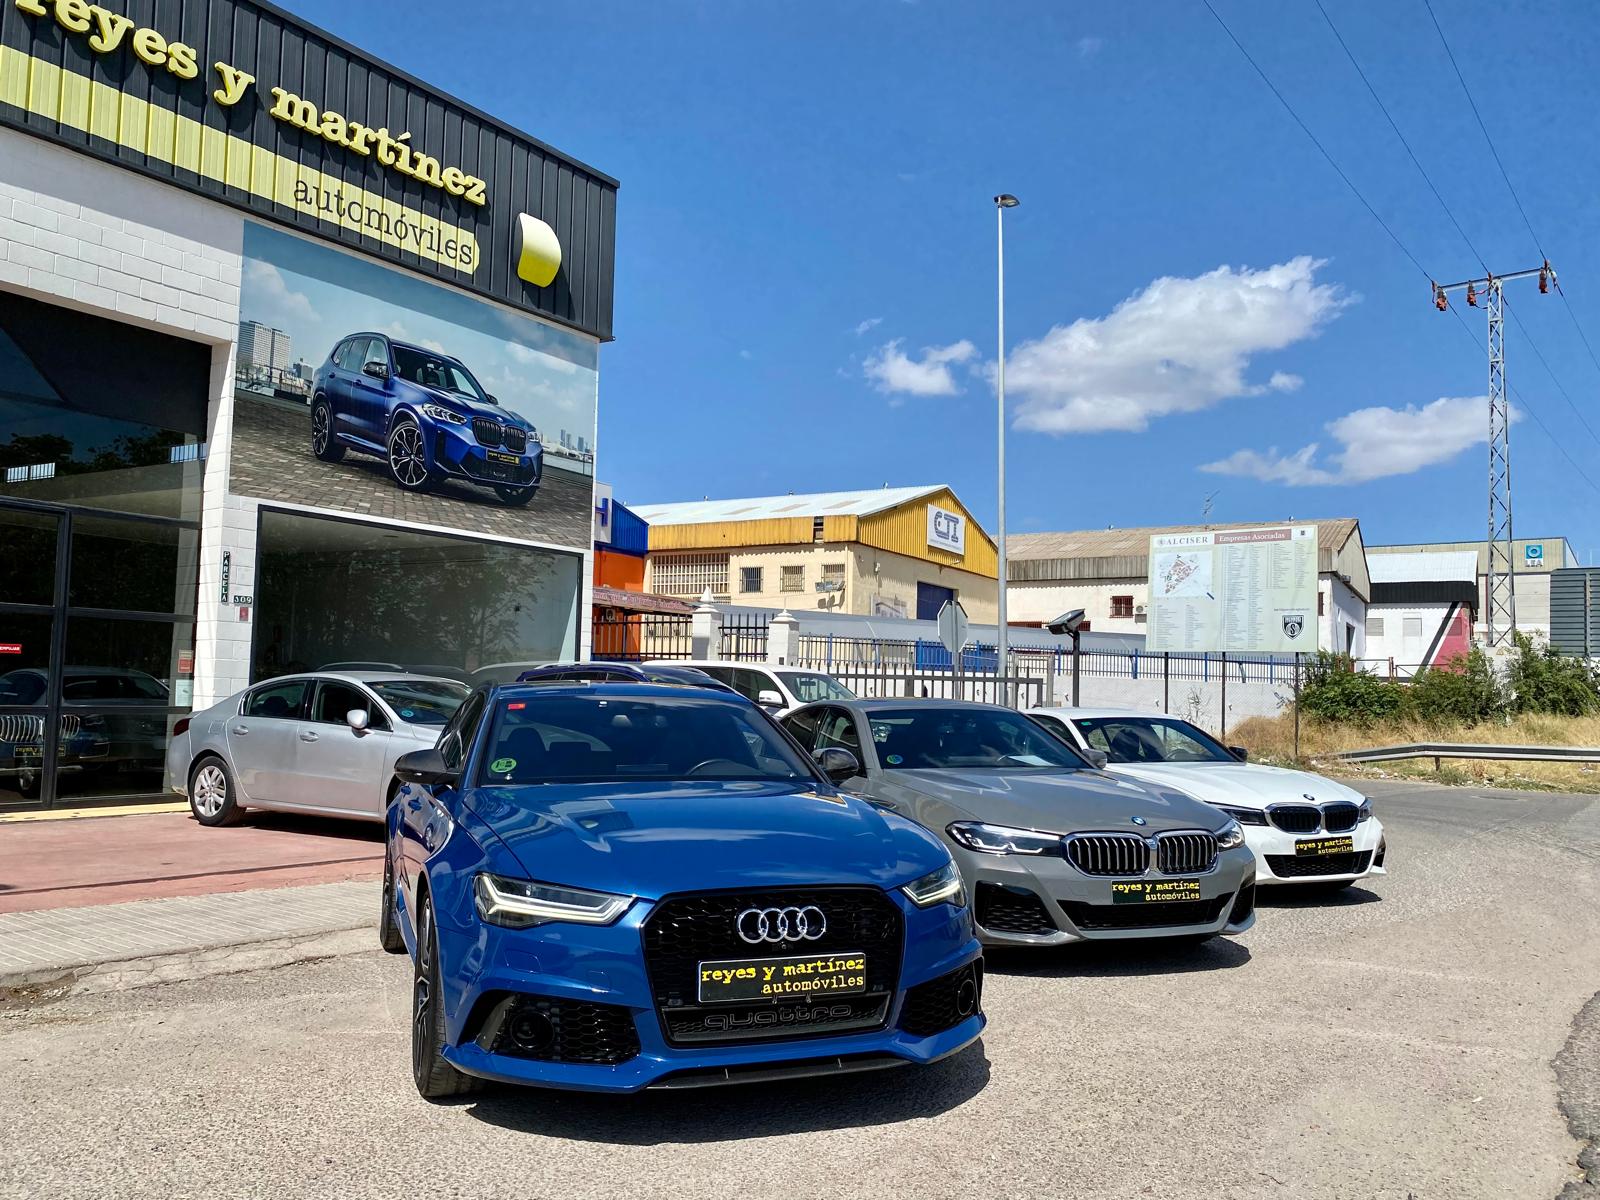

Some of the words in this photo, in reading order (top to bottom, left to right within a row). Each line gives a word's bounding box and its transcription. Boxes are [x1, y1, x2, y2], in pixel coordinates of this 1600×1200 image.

[214, 61, 256, 106] y
[270, 86, 487, 206] martínez
[293, 179, 473, 265] automóviles
[1167, 536, 1208, 545] ALCISER
[1219, 534, 1250, 543] Empresas
[1253, 532, 1286, 540] Asociadas
[222, 551, 230, 602] PARCELA
[1112, 883, 1142, 893] reyes
[1145, 883, 1152, 893] y
[1156, 880, 1200, 891] martínez
[1145, 891, 1200, 901] automóviles
[701, 965, 757, 985] reyes
[762, 965, 777, 981] y
[783, 957, 865, 977] martínez
[762, 974, 865, 995] automóviles
[705, 1005, 852, 1030] quattro
